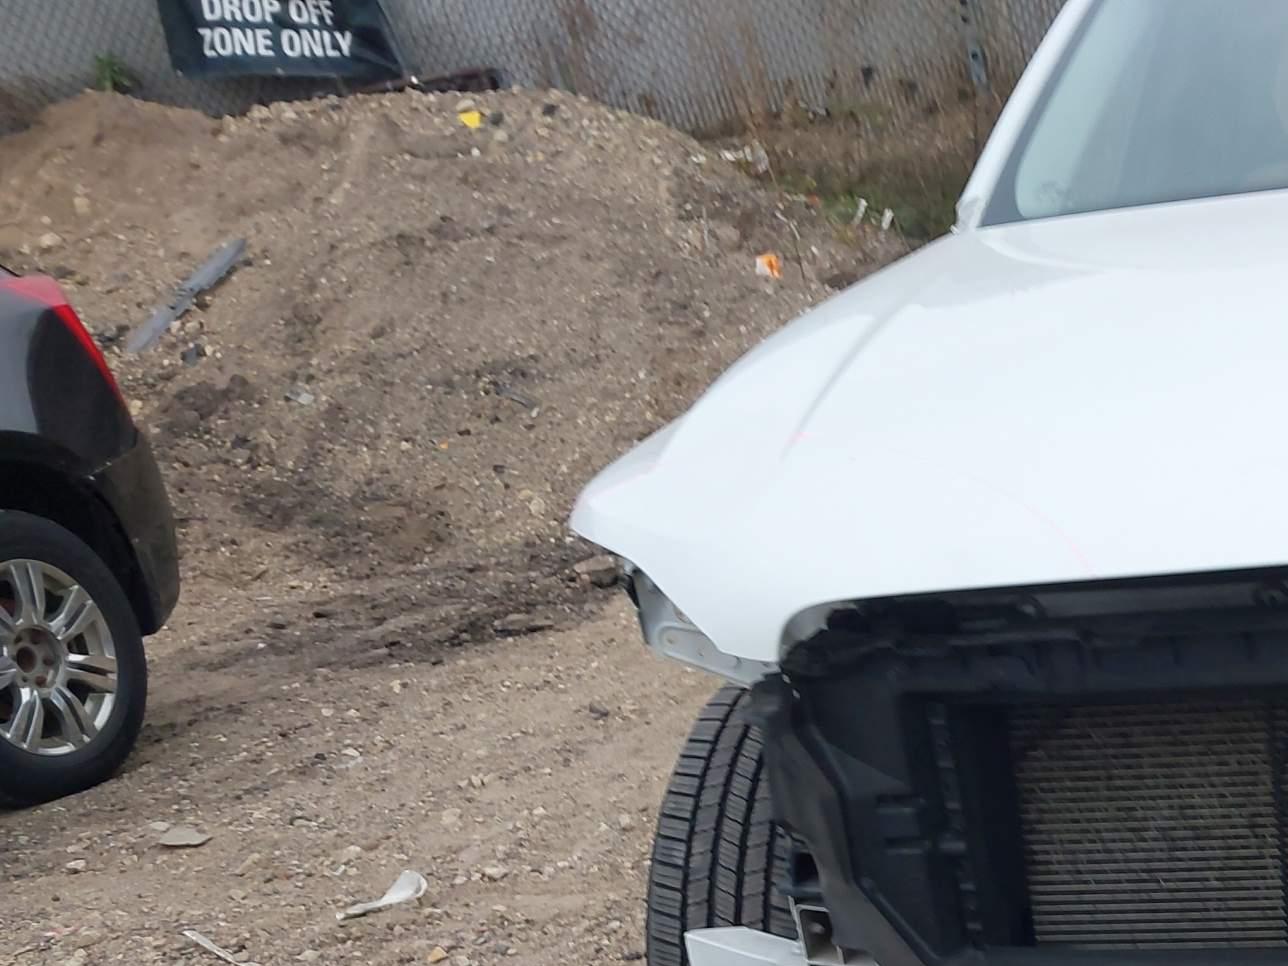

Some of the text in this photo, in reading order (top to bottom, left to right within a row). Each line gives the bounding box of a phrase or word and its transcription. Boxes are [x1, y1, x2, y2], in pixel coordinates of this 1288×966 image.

[200, 0, 334, 26] DROP OFF
[198, 27, 353, 58] ZONE ONLY
